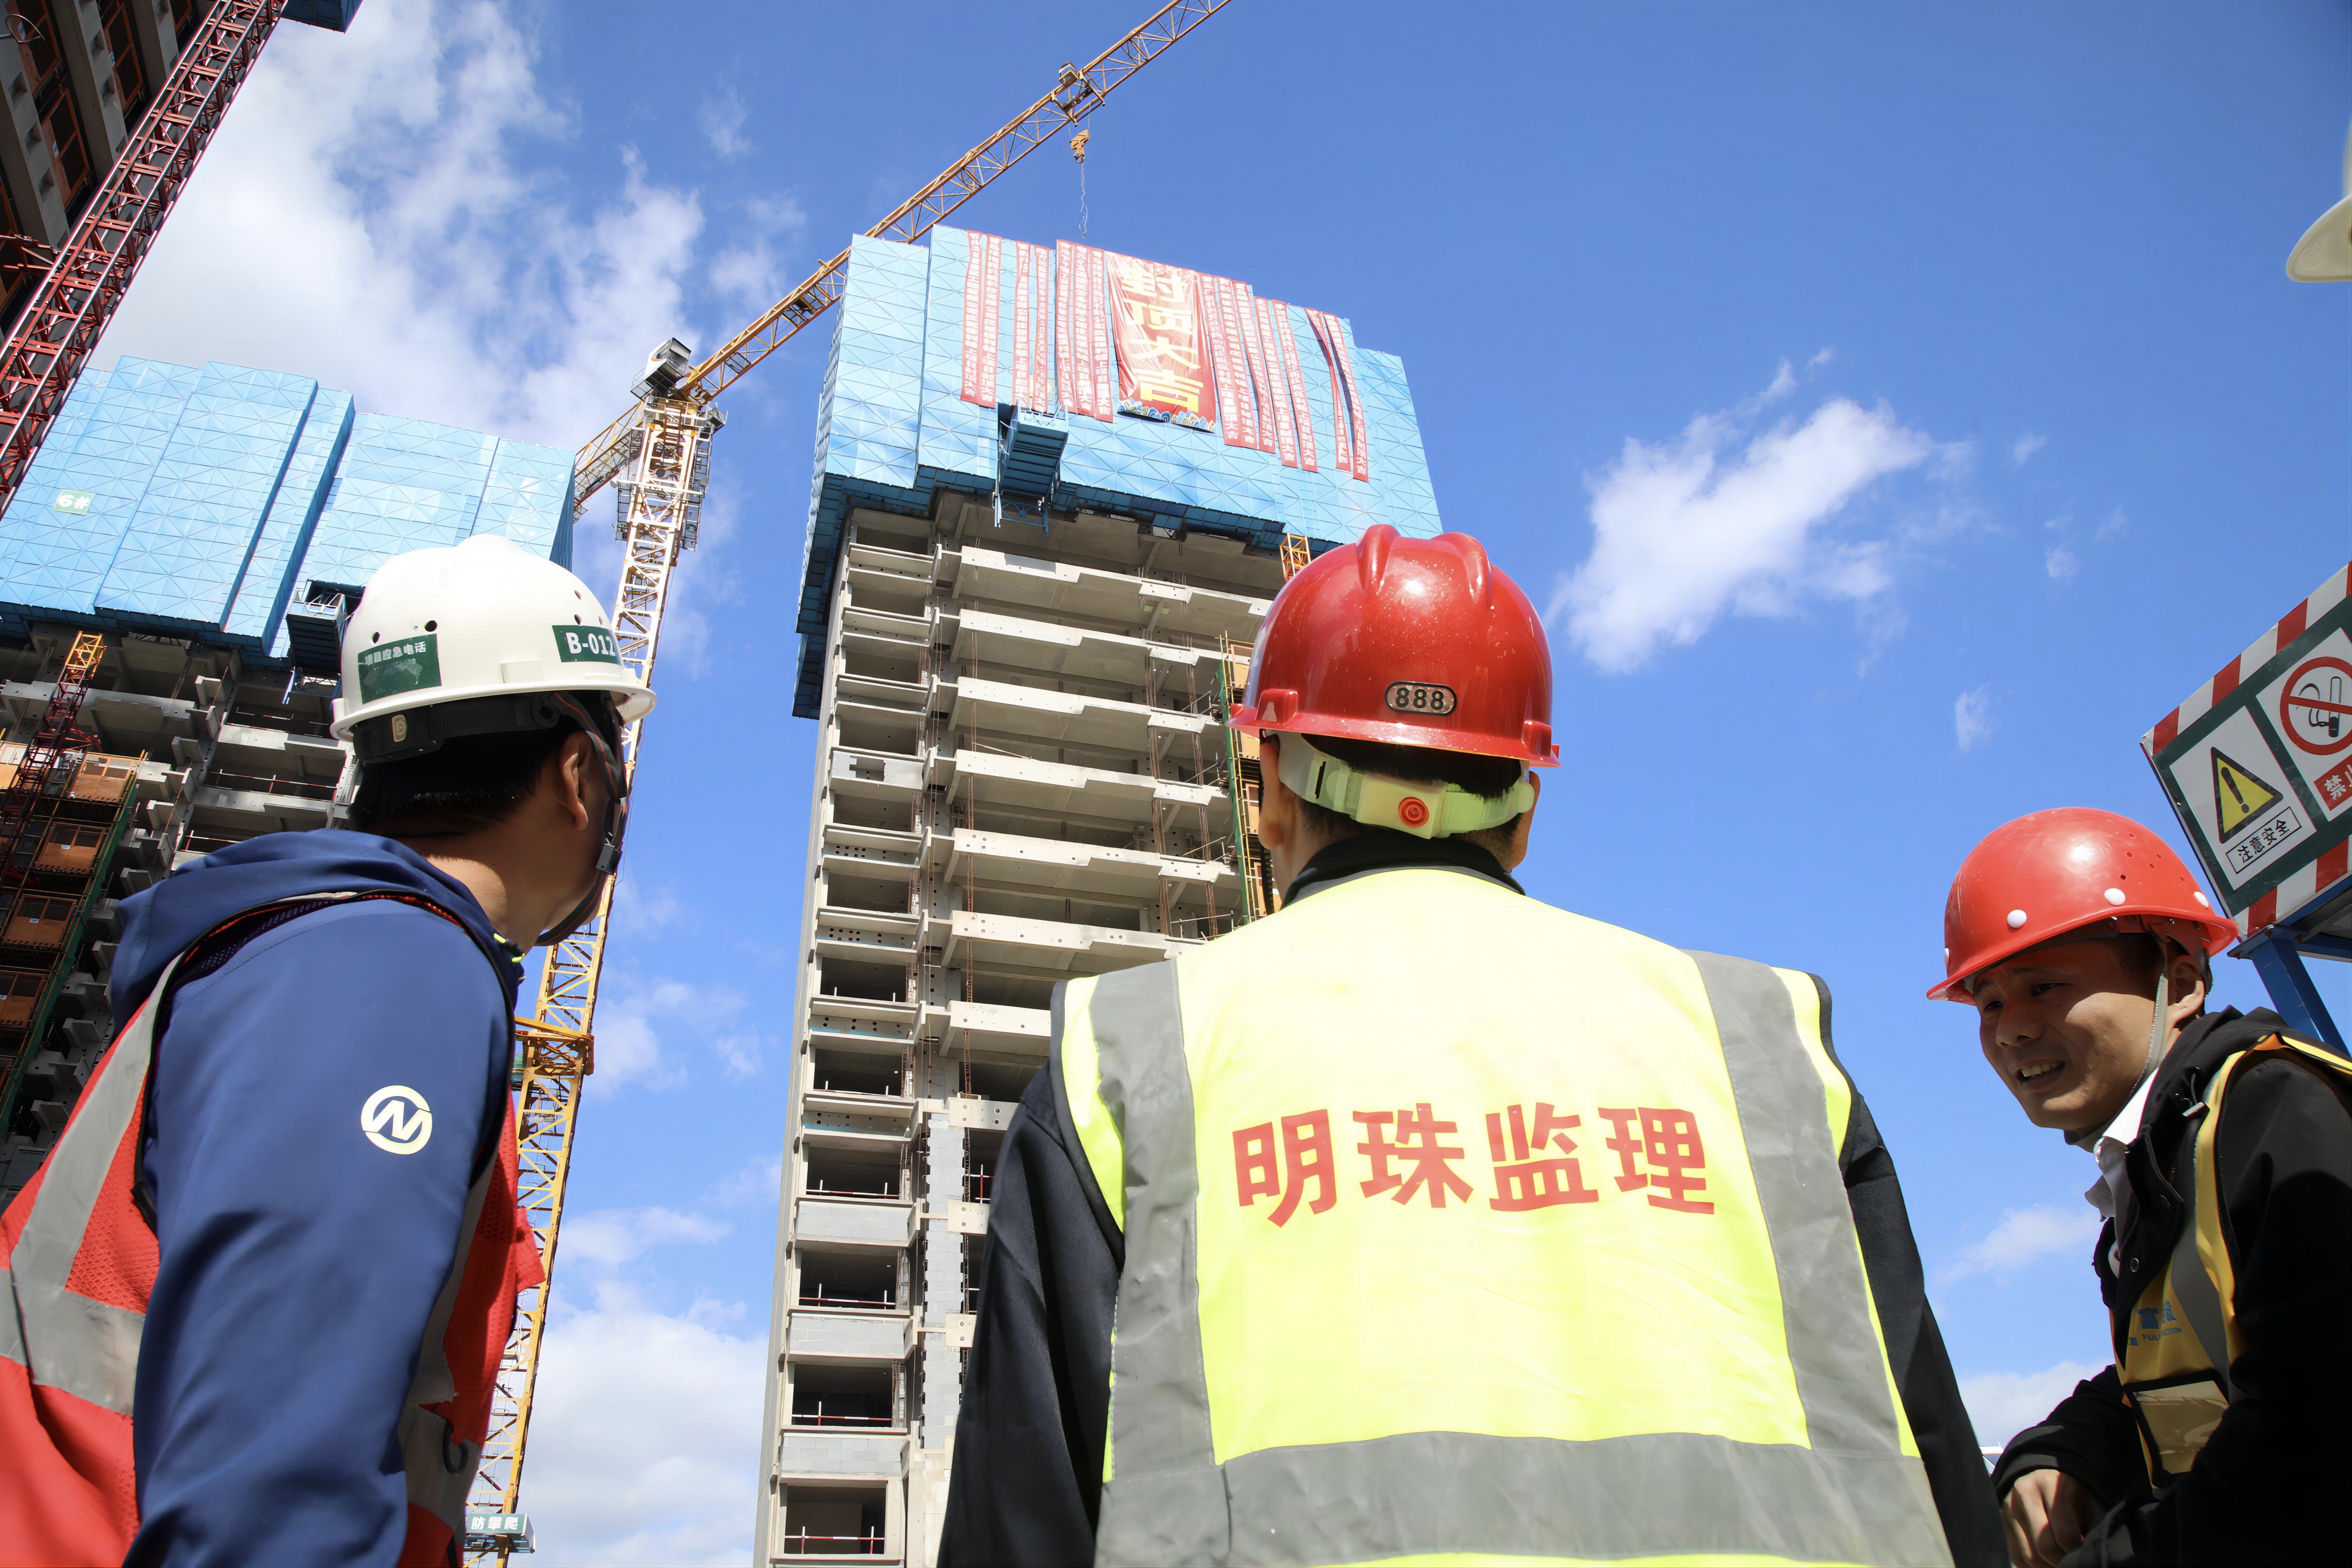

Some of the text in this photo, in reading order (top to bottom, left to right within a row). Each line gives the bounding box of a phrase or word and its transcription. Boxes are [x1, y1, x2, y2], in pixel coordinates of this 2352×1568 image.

[1120, 259, 1204, 413] 封顶大吉
[58, 494, 90, 509] 6#
[565, 632, 616, 656] B-012
[1396, 687, 1444, 710] 888
[2237, 819, 2290, 863] 注意安全
[1232, 1102, 1714, 1228] 明珠监理
